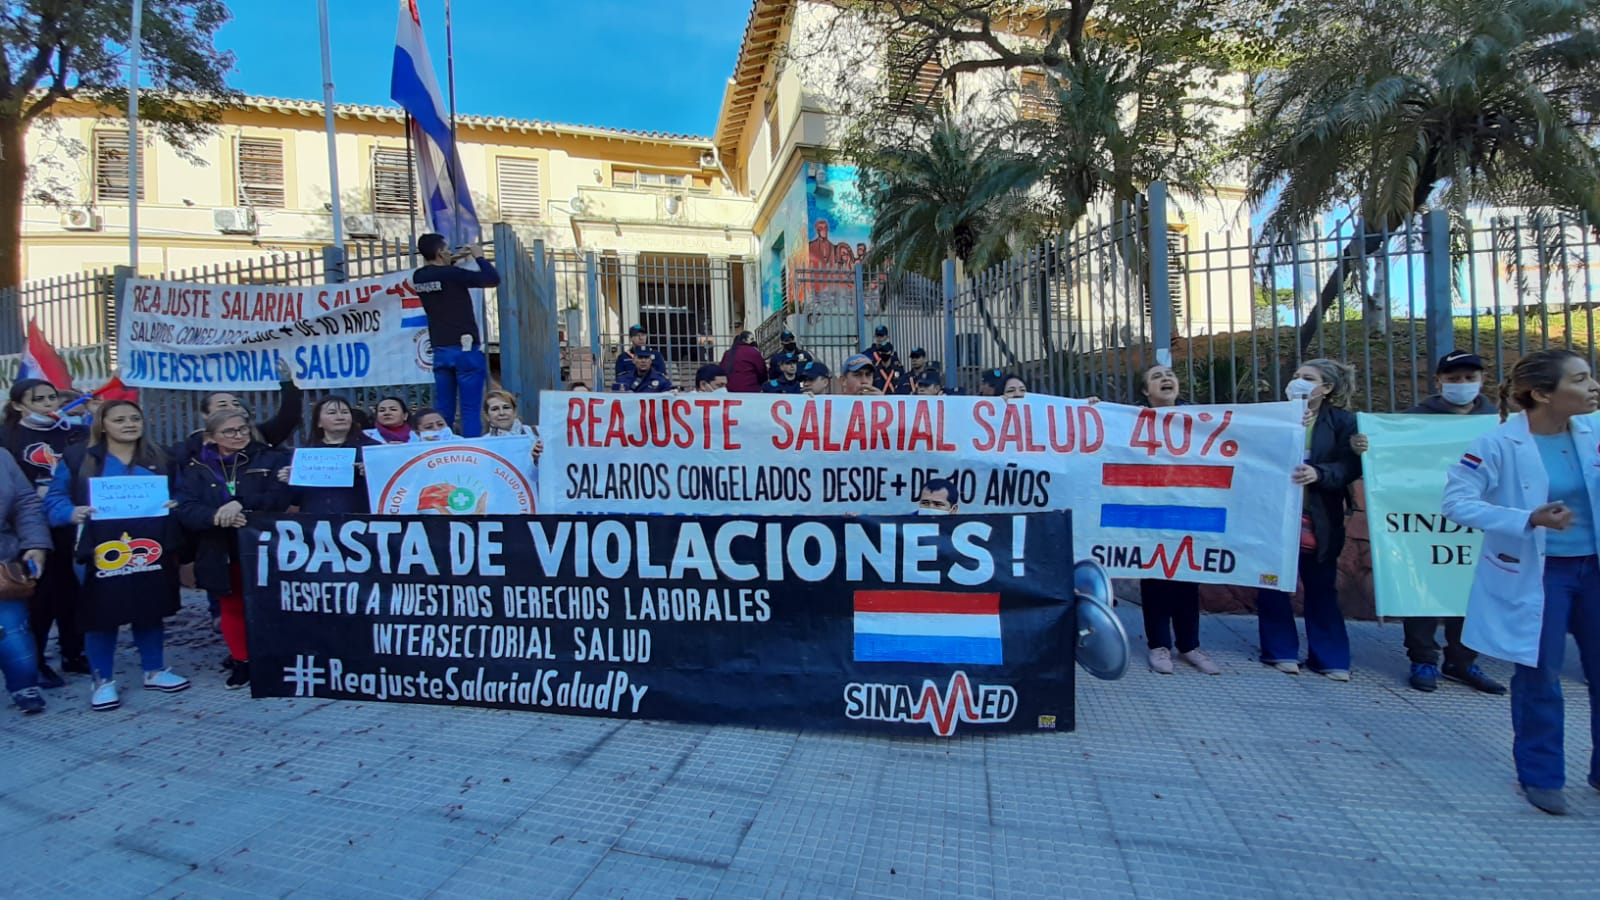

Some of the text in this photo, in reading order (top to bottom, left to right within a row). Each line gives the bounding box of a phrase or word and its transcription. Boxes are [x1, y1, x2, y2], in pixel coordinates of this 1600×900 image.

[133, 285, 211, 319] REAJUSTE
[221, 290, 303, 323] SALARIAL
[316, 316, 340, 335] 10
[344, 309, 382, 334] AÑOS
[296, 342, 371, 380] SALUD
[566, 397, 1239, 457] REAJUSTE SALARIAL SALUD 40%
[426, 454, 480, 469] GREMIAL
[493, 466, 520, 491] SALUD
[518, 490, 528, 506] NO
[566, 463, 671, 500] SALARIOS
[676, 464, 812, 502] CONGELADOS
[822, 467, 887, 502] DESDE
[984, 463, 1051, 508] AÑOS
[1386, 512, 1486, 534] SIND
[257, 515, 1027, 587] ¡BASTA DE VIOLACIONES!
[1091, 535, 1236, 579] SINAMED
[1432, 544, 1472, 566] DE
[280, 581, 772, 623] RESPETO A NUESTROS DERECHOS LABORALES
[372, 623, 652, 664] INTERSECTORIAL SALUD
[283, 654, 649, 714] #ReajusteSalarialSaludPy
[844, 670, 1018, 737] SINAMED
